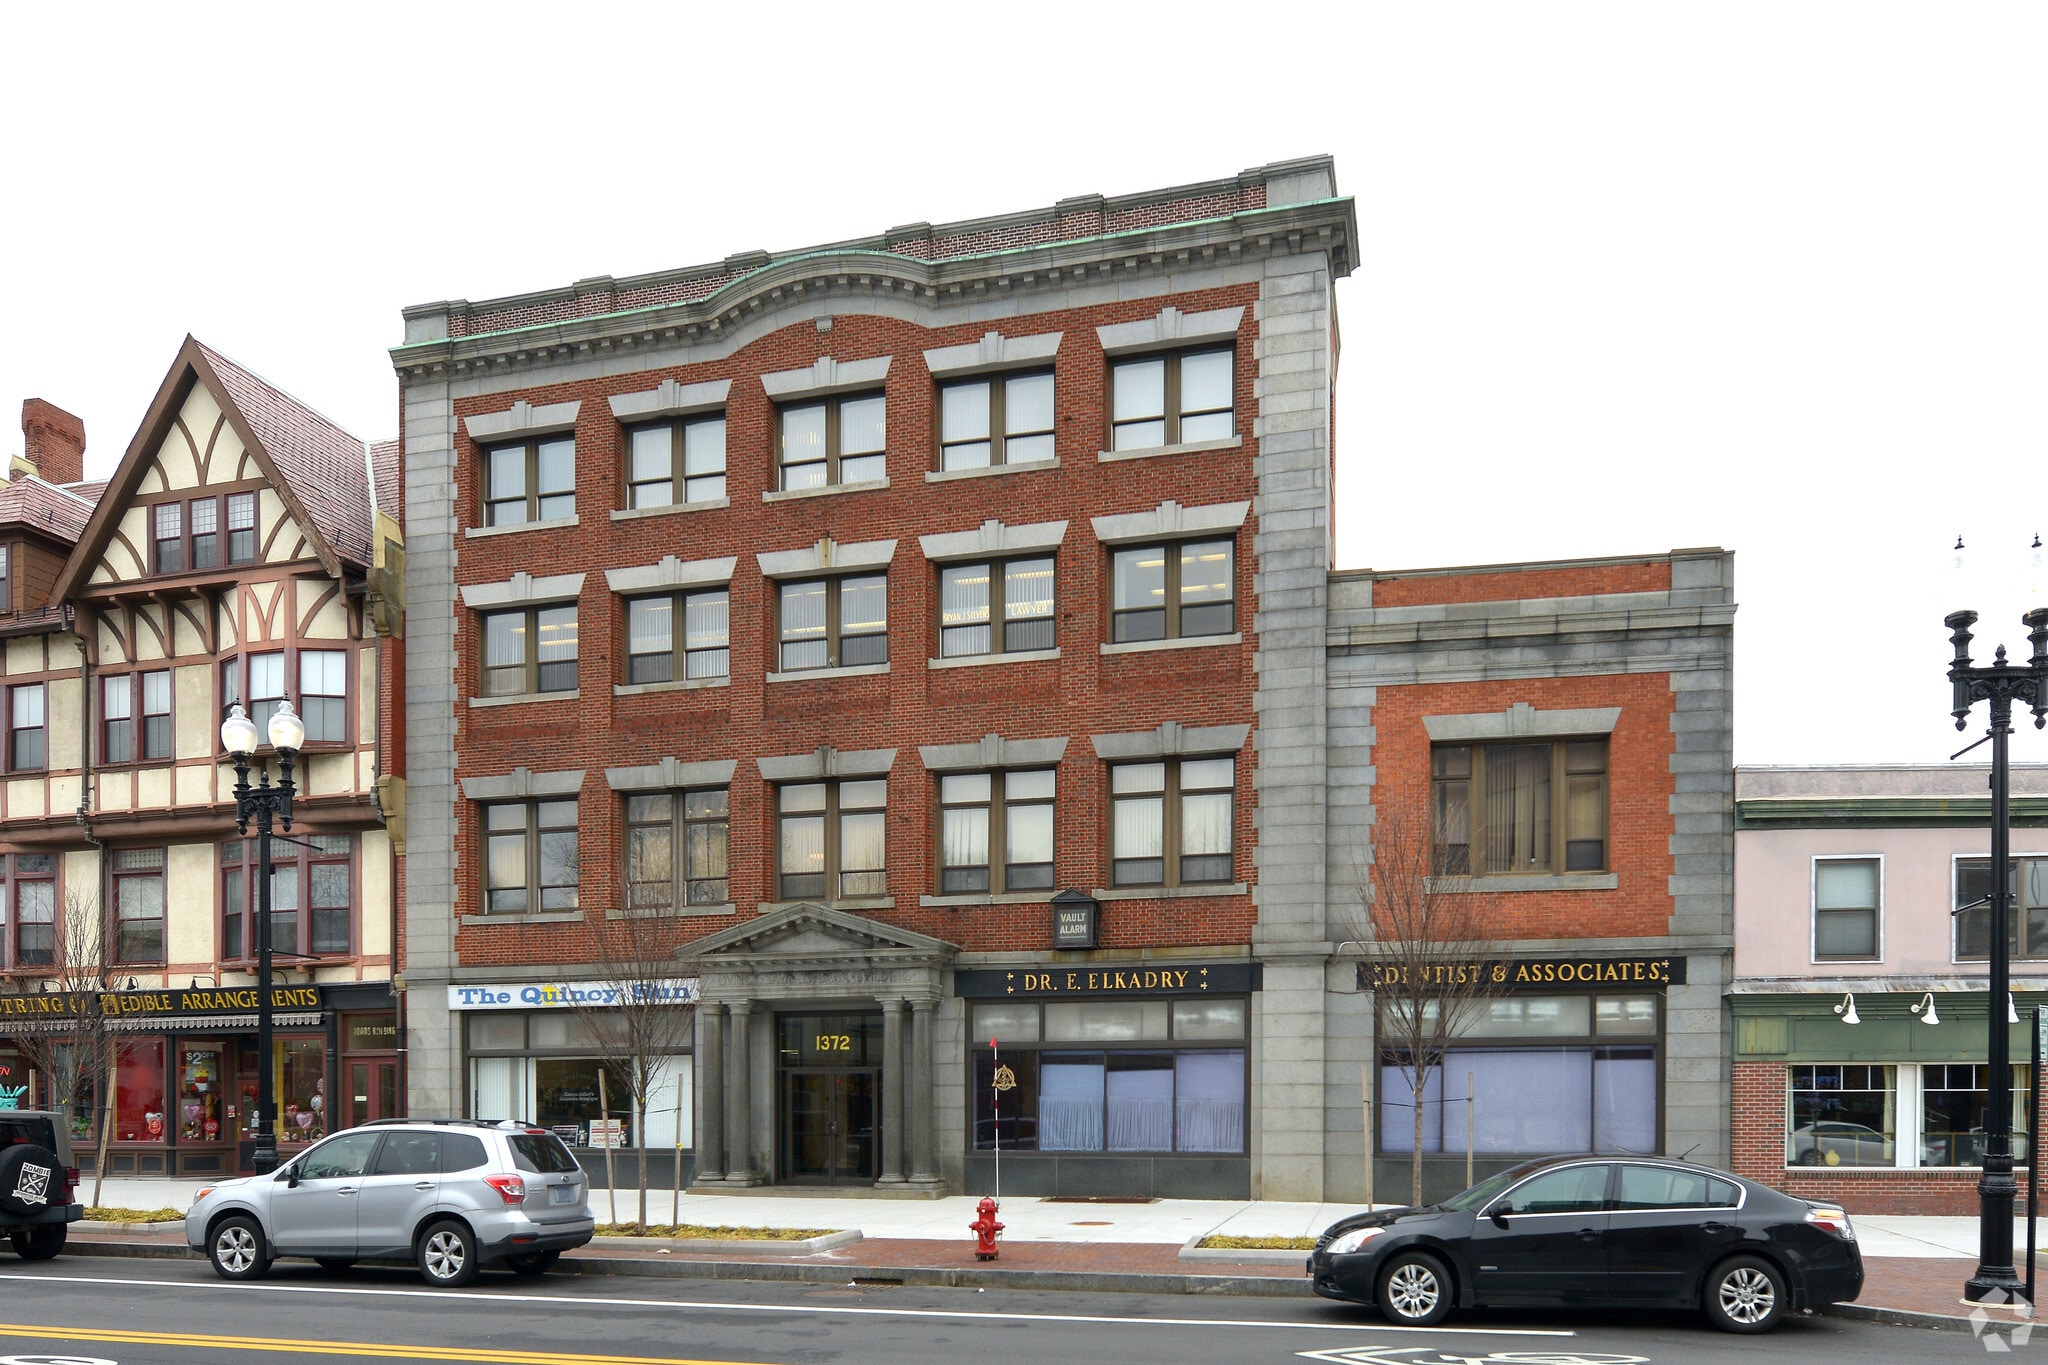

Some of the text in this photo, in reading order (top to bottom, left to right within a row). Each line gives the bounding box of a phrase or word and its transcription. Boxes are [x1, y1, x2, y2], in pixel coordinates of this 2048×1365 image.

[943, 612, 961, 622] BRYAN
[967, 608, 990, 620] STEVENS
[1011, 603, 1048, 616] LAWYER
[1060, 913, 1086, 922] VAULT
[1060, 924, 1087, 934] ALARM
[1491, 965, 1507, 983] &
[1515, 961, 1661, 982] ASSOCIATES
[1024, 970, 1189, 992] DR. E. ELKADRY
[121, 988, 318, 1012] EDIBLE ARRANGEENTS
[458, 983, 691, 1005] The Quincy Sun
[816, 1035, 850, 1051] 1372
